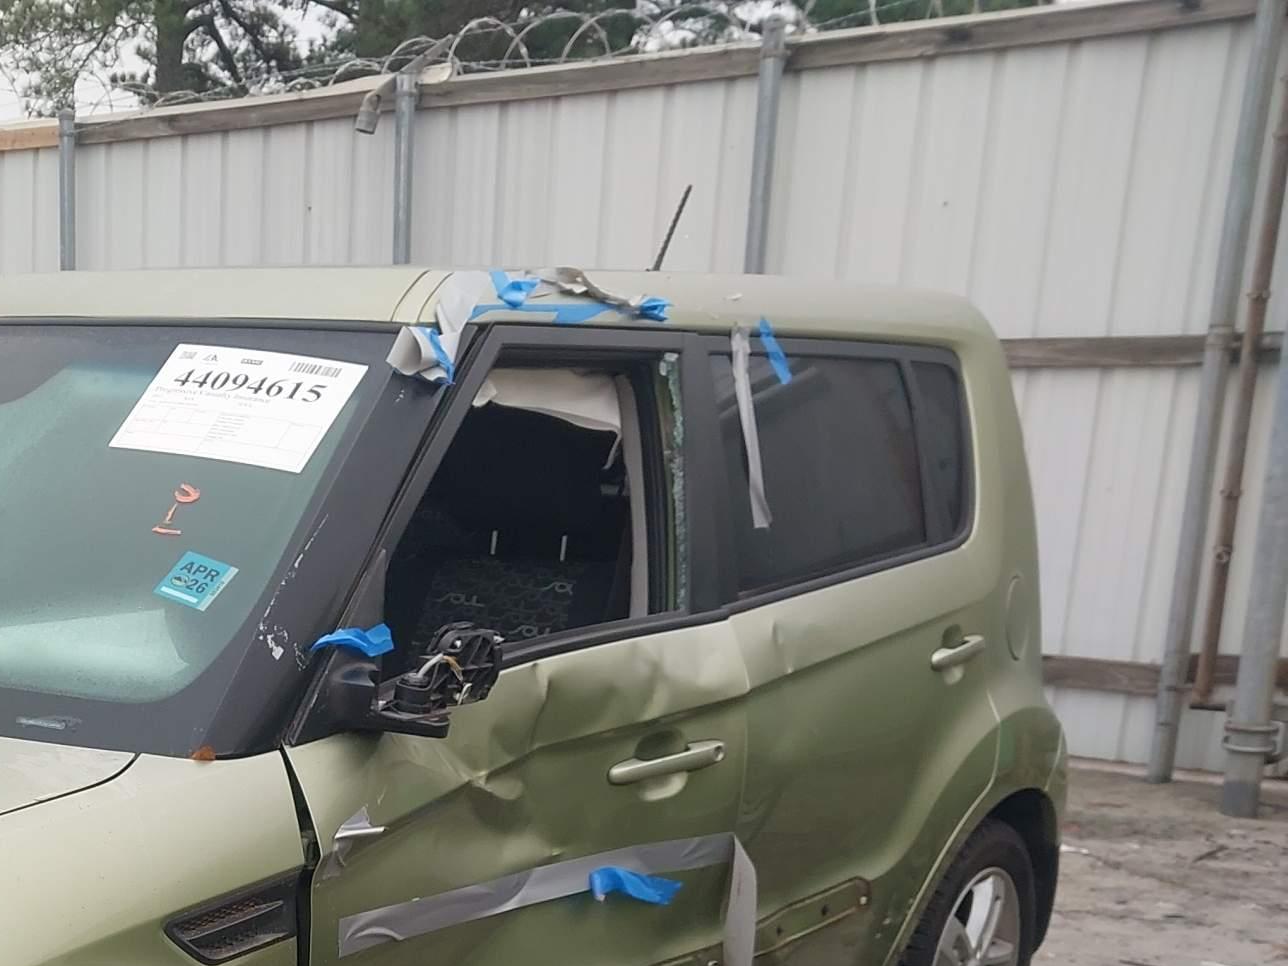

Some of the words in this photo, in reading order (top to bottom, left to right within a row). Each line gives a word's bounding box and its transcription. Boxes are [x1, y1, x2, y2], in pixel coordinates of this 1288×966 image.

[173, 368, 328, 403] 44094615
[179, 561, 221, 583] APR
[185, 578, 209, 594] 26
